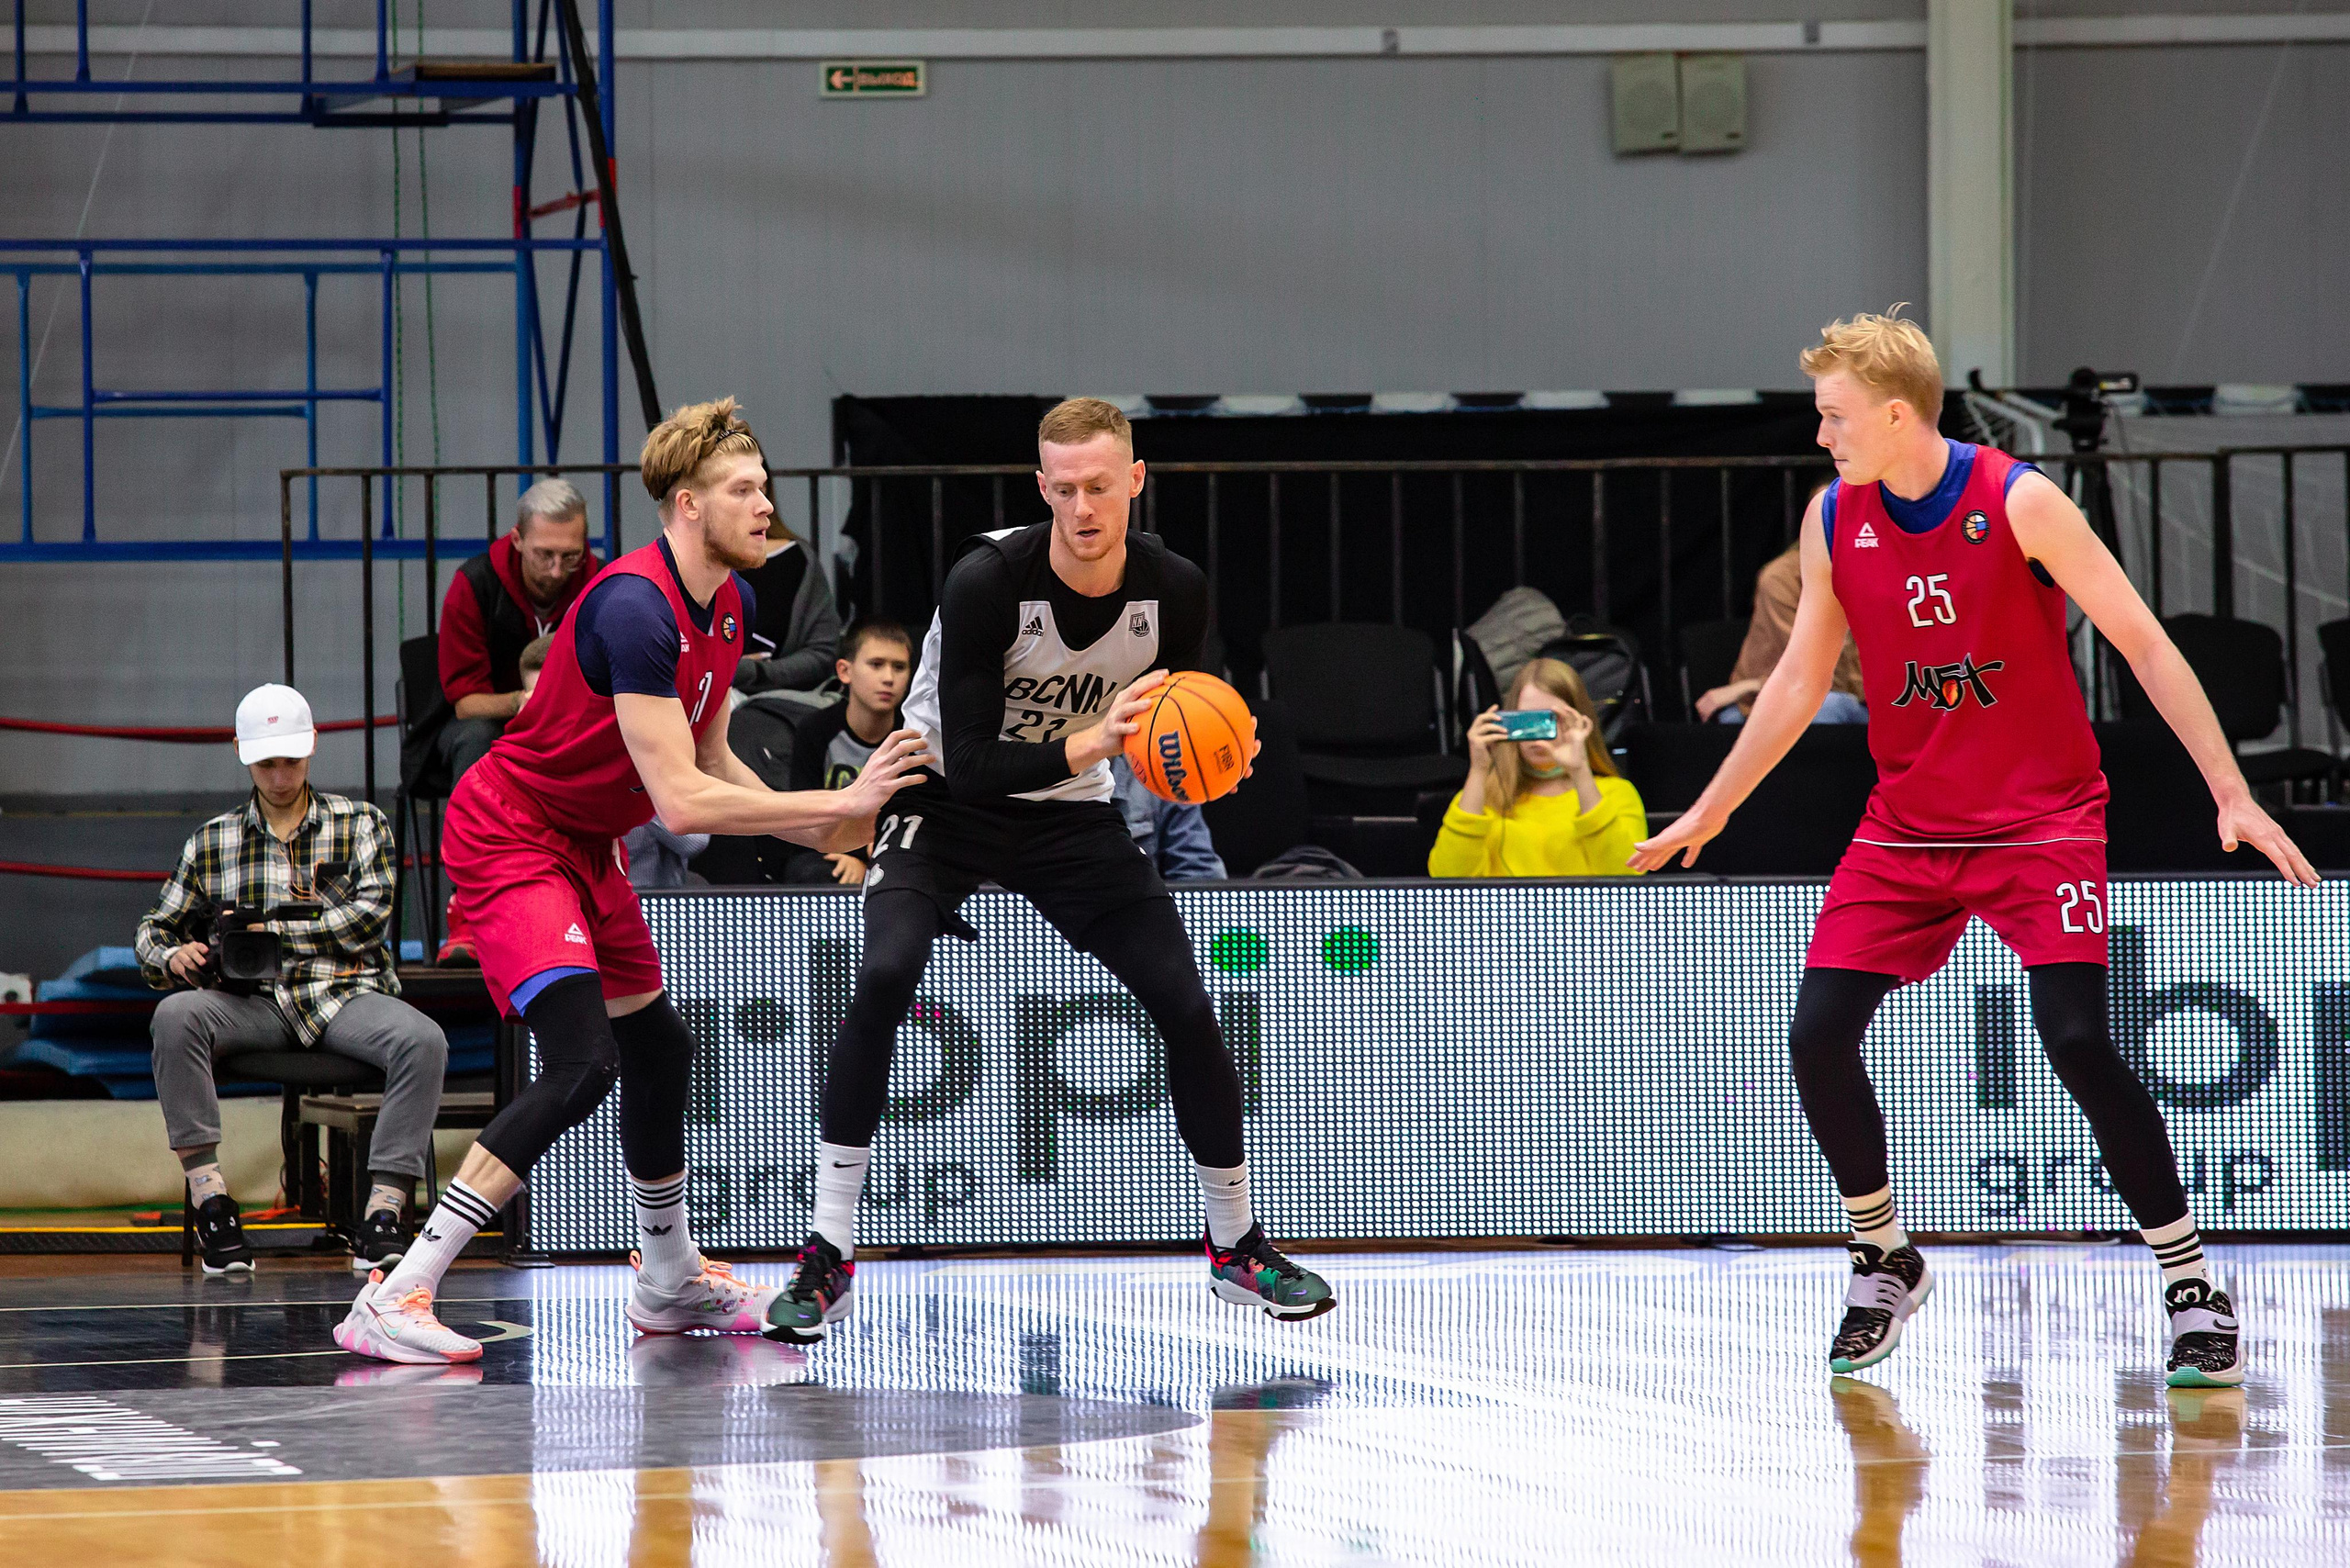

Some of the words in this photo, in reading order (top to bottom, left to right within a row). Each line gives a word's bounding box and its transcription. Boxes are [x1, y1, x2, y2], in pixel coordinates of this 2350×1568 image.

[1854, 538, 1879, 548] PEAK
[1905, 572, 1958, 628] 25
[1004, 672, 1118, 715] BCNN
[1004, 709, 1069, 743] 21
[871, 813, 923, 859] 21
[2055, 879, 2104, 935] 25
